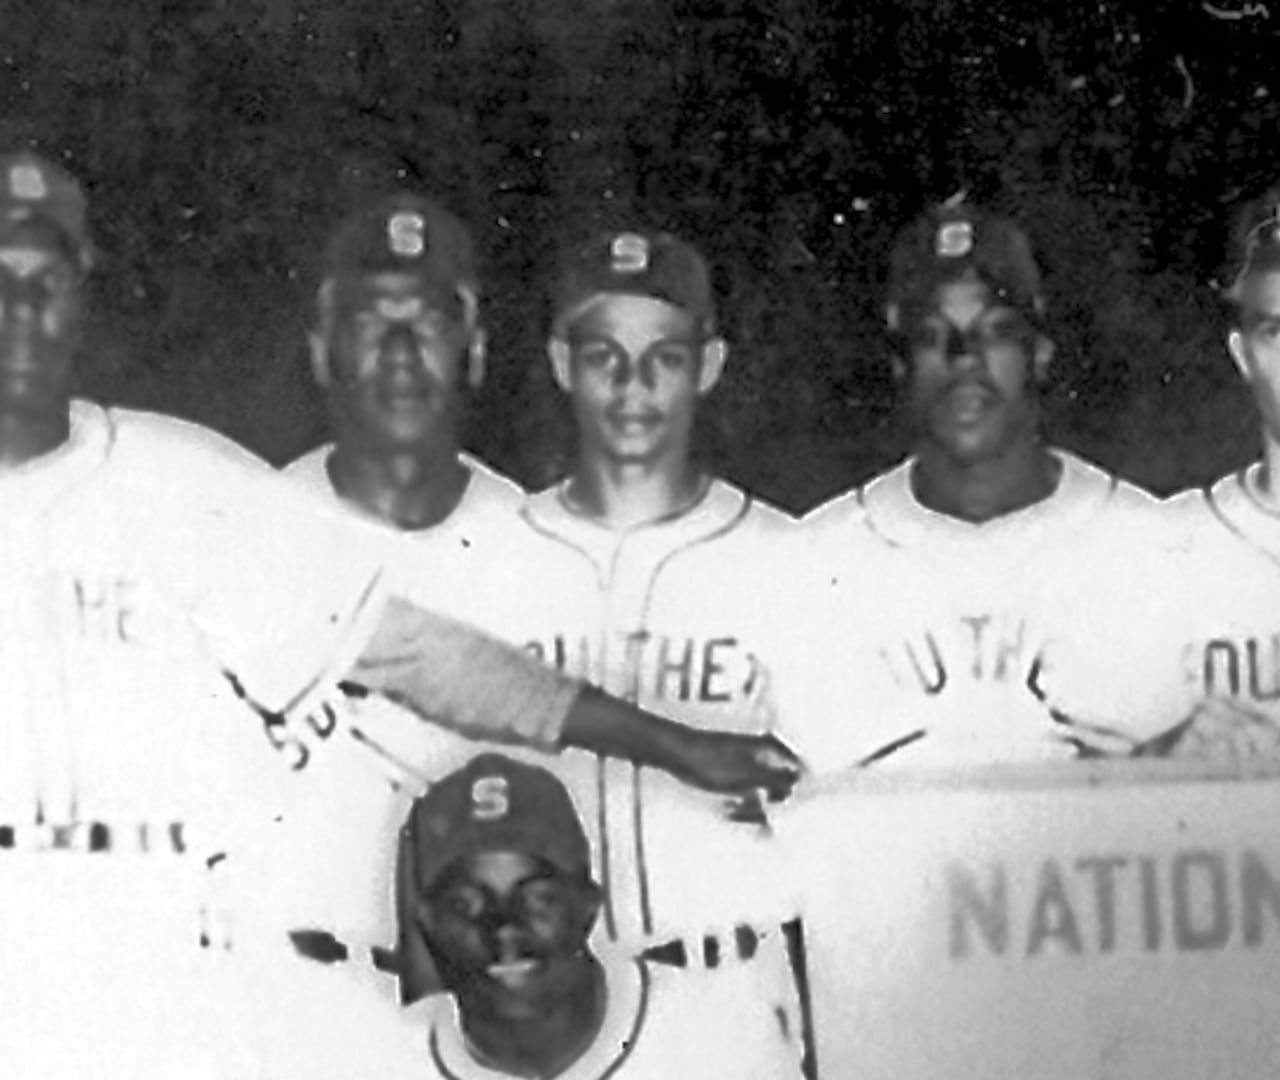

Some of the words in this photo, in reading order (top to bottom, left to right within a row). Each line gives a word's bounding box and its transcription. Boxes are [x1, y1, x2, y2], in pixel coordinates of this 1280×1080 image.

[389, 212, 424, 256] S
[612, 232, 647, 271] S
[936, 222, 973, 257] S
[471, 776, 509, 819] S
